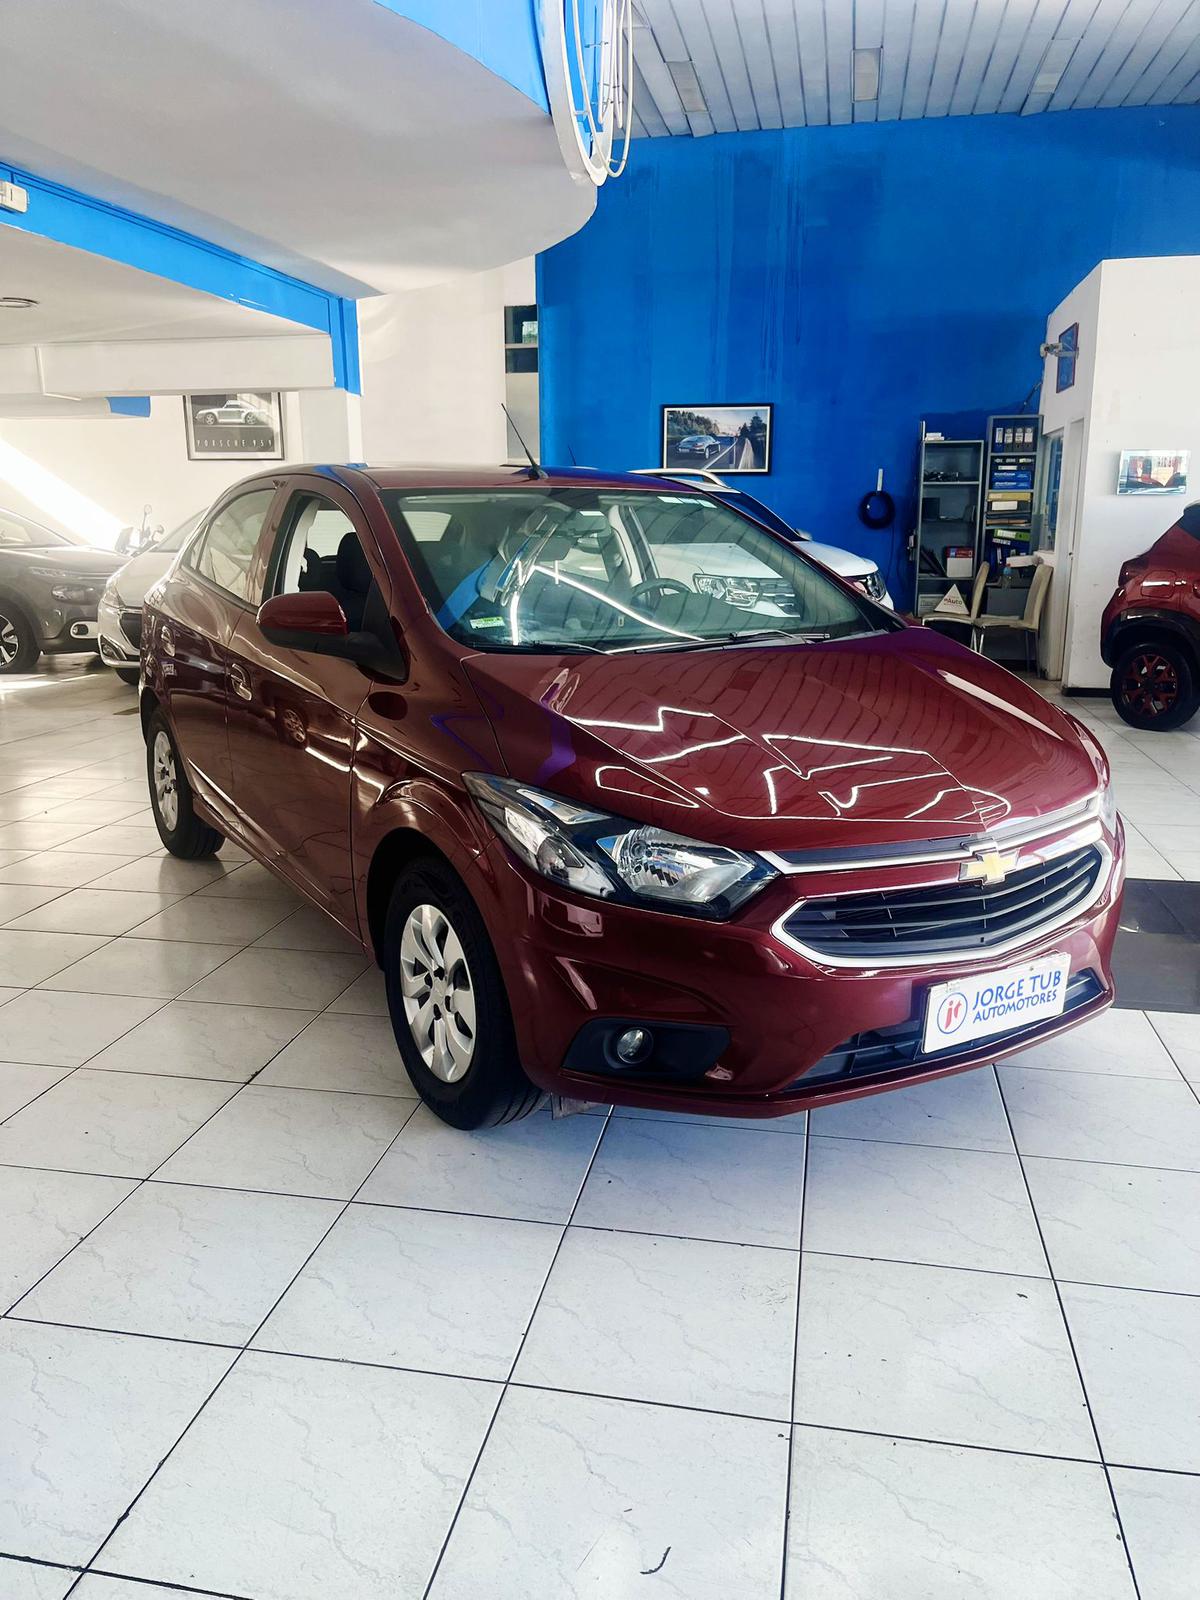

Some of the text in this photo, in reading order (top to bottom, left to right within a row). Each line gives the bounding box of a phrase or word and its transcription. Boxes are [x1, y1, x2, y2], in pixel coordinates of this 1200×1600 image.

[197, 439, 246, 447] PORSCHE
[972, 970, 1061, 1010] JORGE TUB
[972, 989, 1057, 1024] AUTOMOTORES
